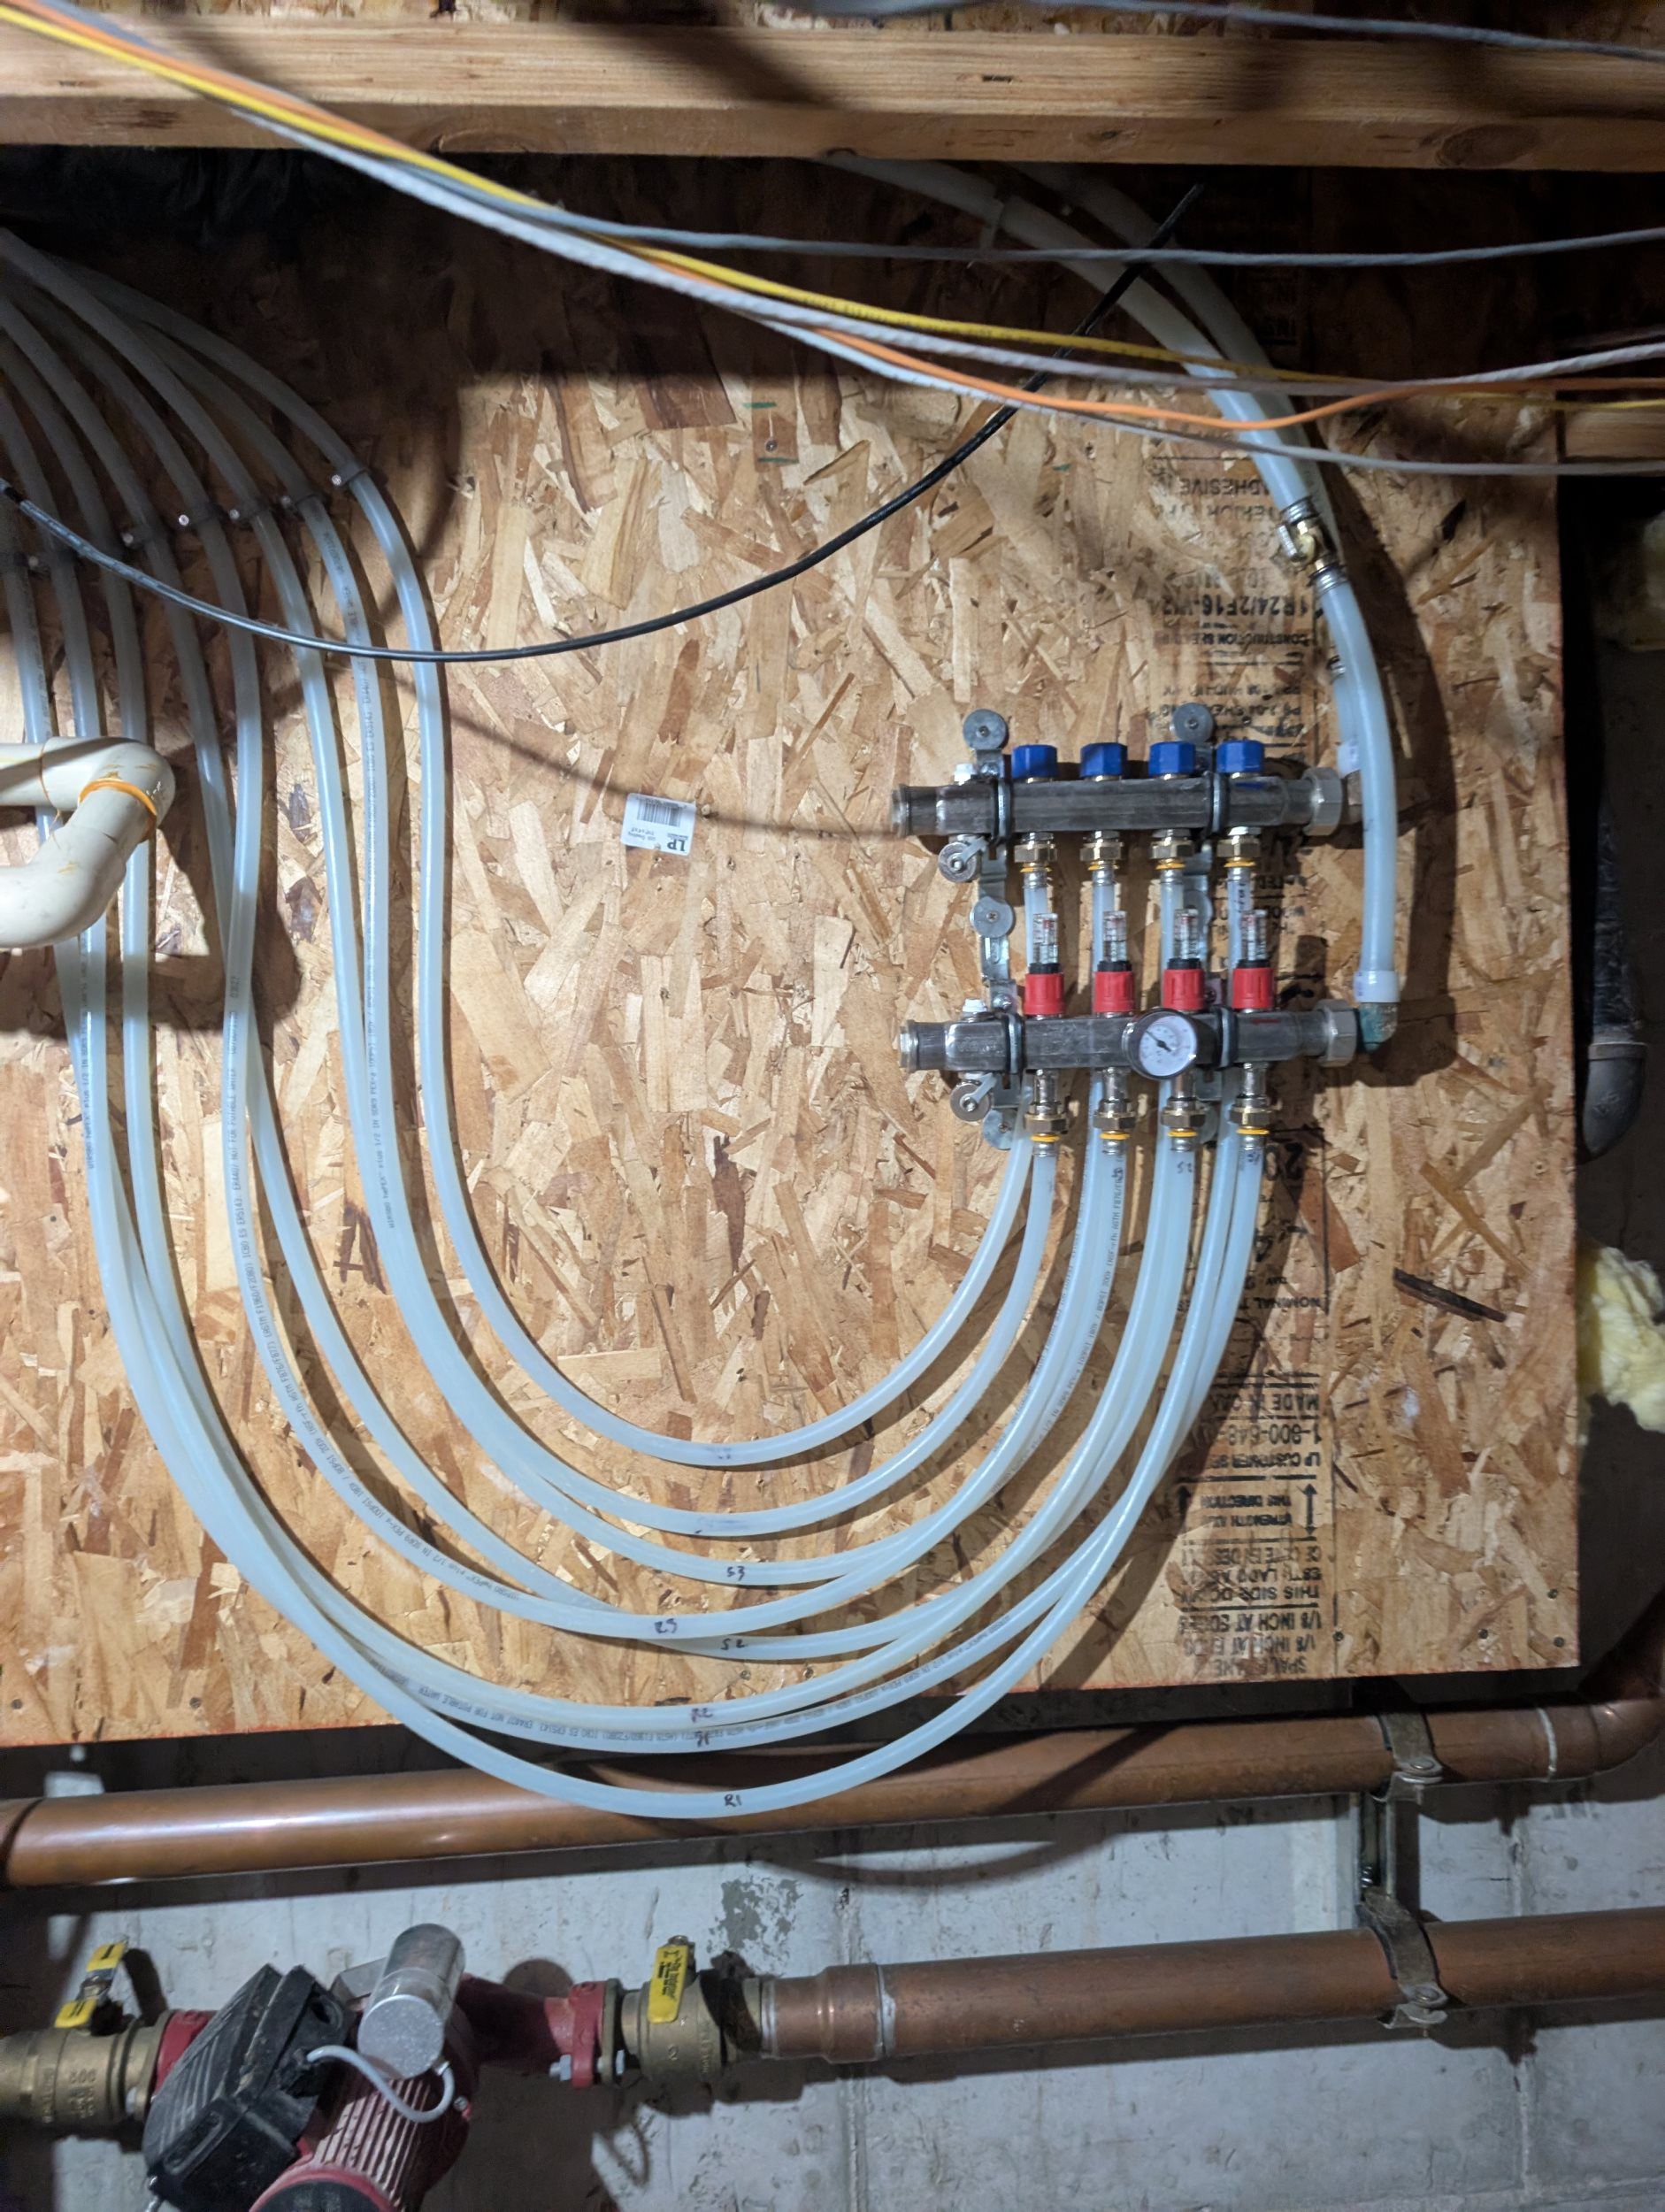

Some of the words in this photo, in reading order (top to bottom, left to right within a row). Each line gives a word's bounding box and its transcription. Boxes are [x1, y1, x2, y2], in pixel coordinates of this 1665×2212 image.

[667, 839, 685, 851] LP
[1283, 1585, 1320, 1600] THIS
[1234, 1613, 1254, 1632] AT
[1258, 1613, 1295, 1631] INCH
[724, 1793, 742, 1809] R1
